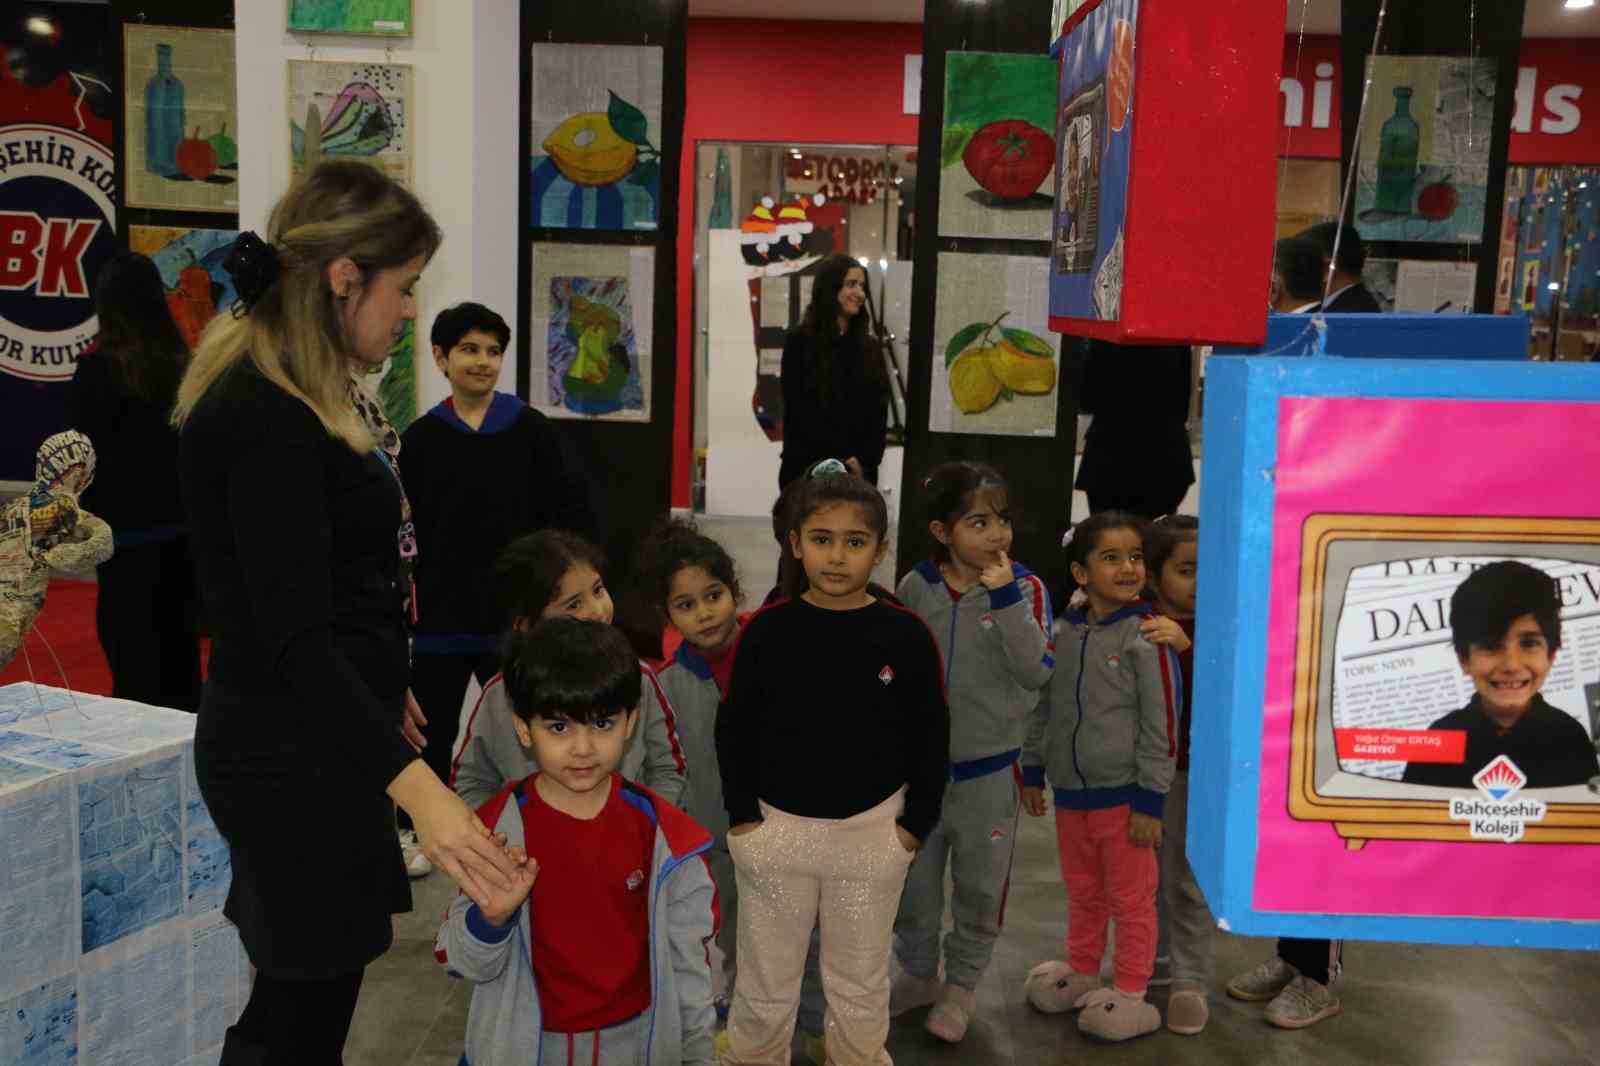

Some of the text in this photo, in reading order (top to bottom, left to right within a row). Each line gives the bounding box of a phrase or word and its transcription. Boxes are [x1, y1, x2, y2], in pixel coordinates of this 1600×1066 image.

[1366, 598, 1448, 643] DAI
[1454, 801, 1542, 817] Bahçeşehir
[1475, 820, 1520, 837] Koleji
